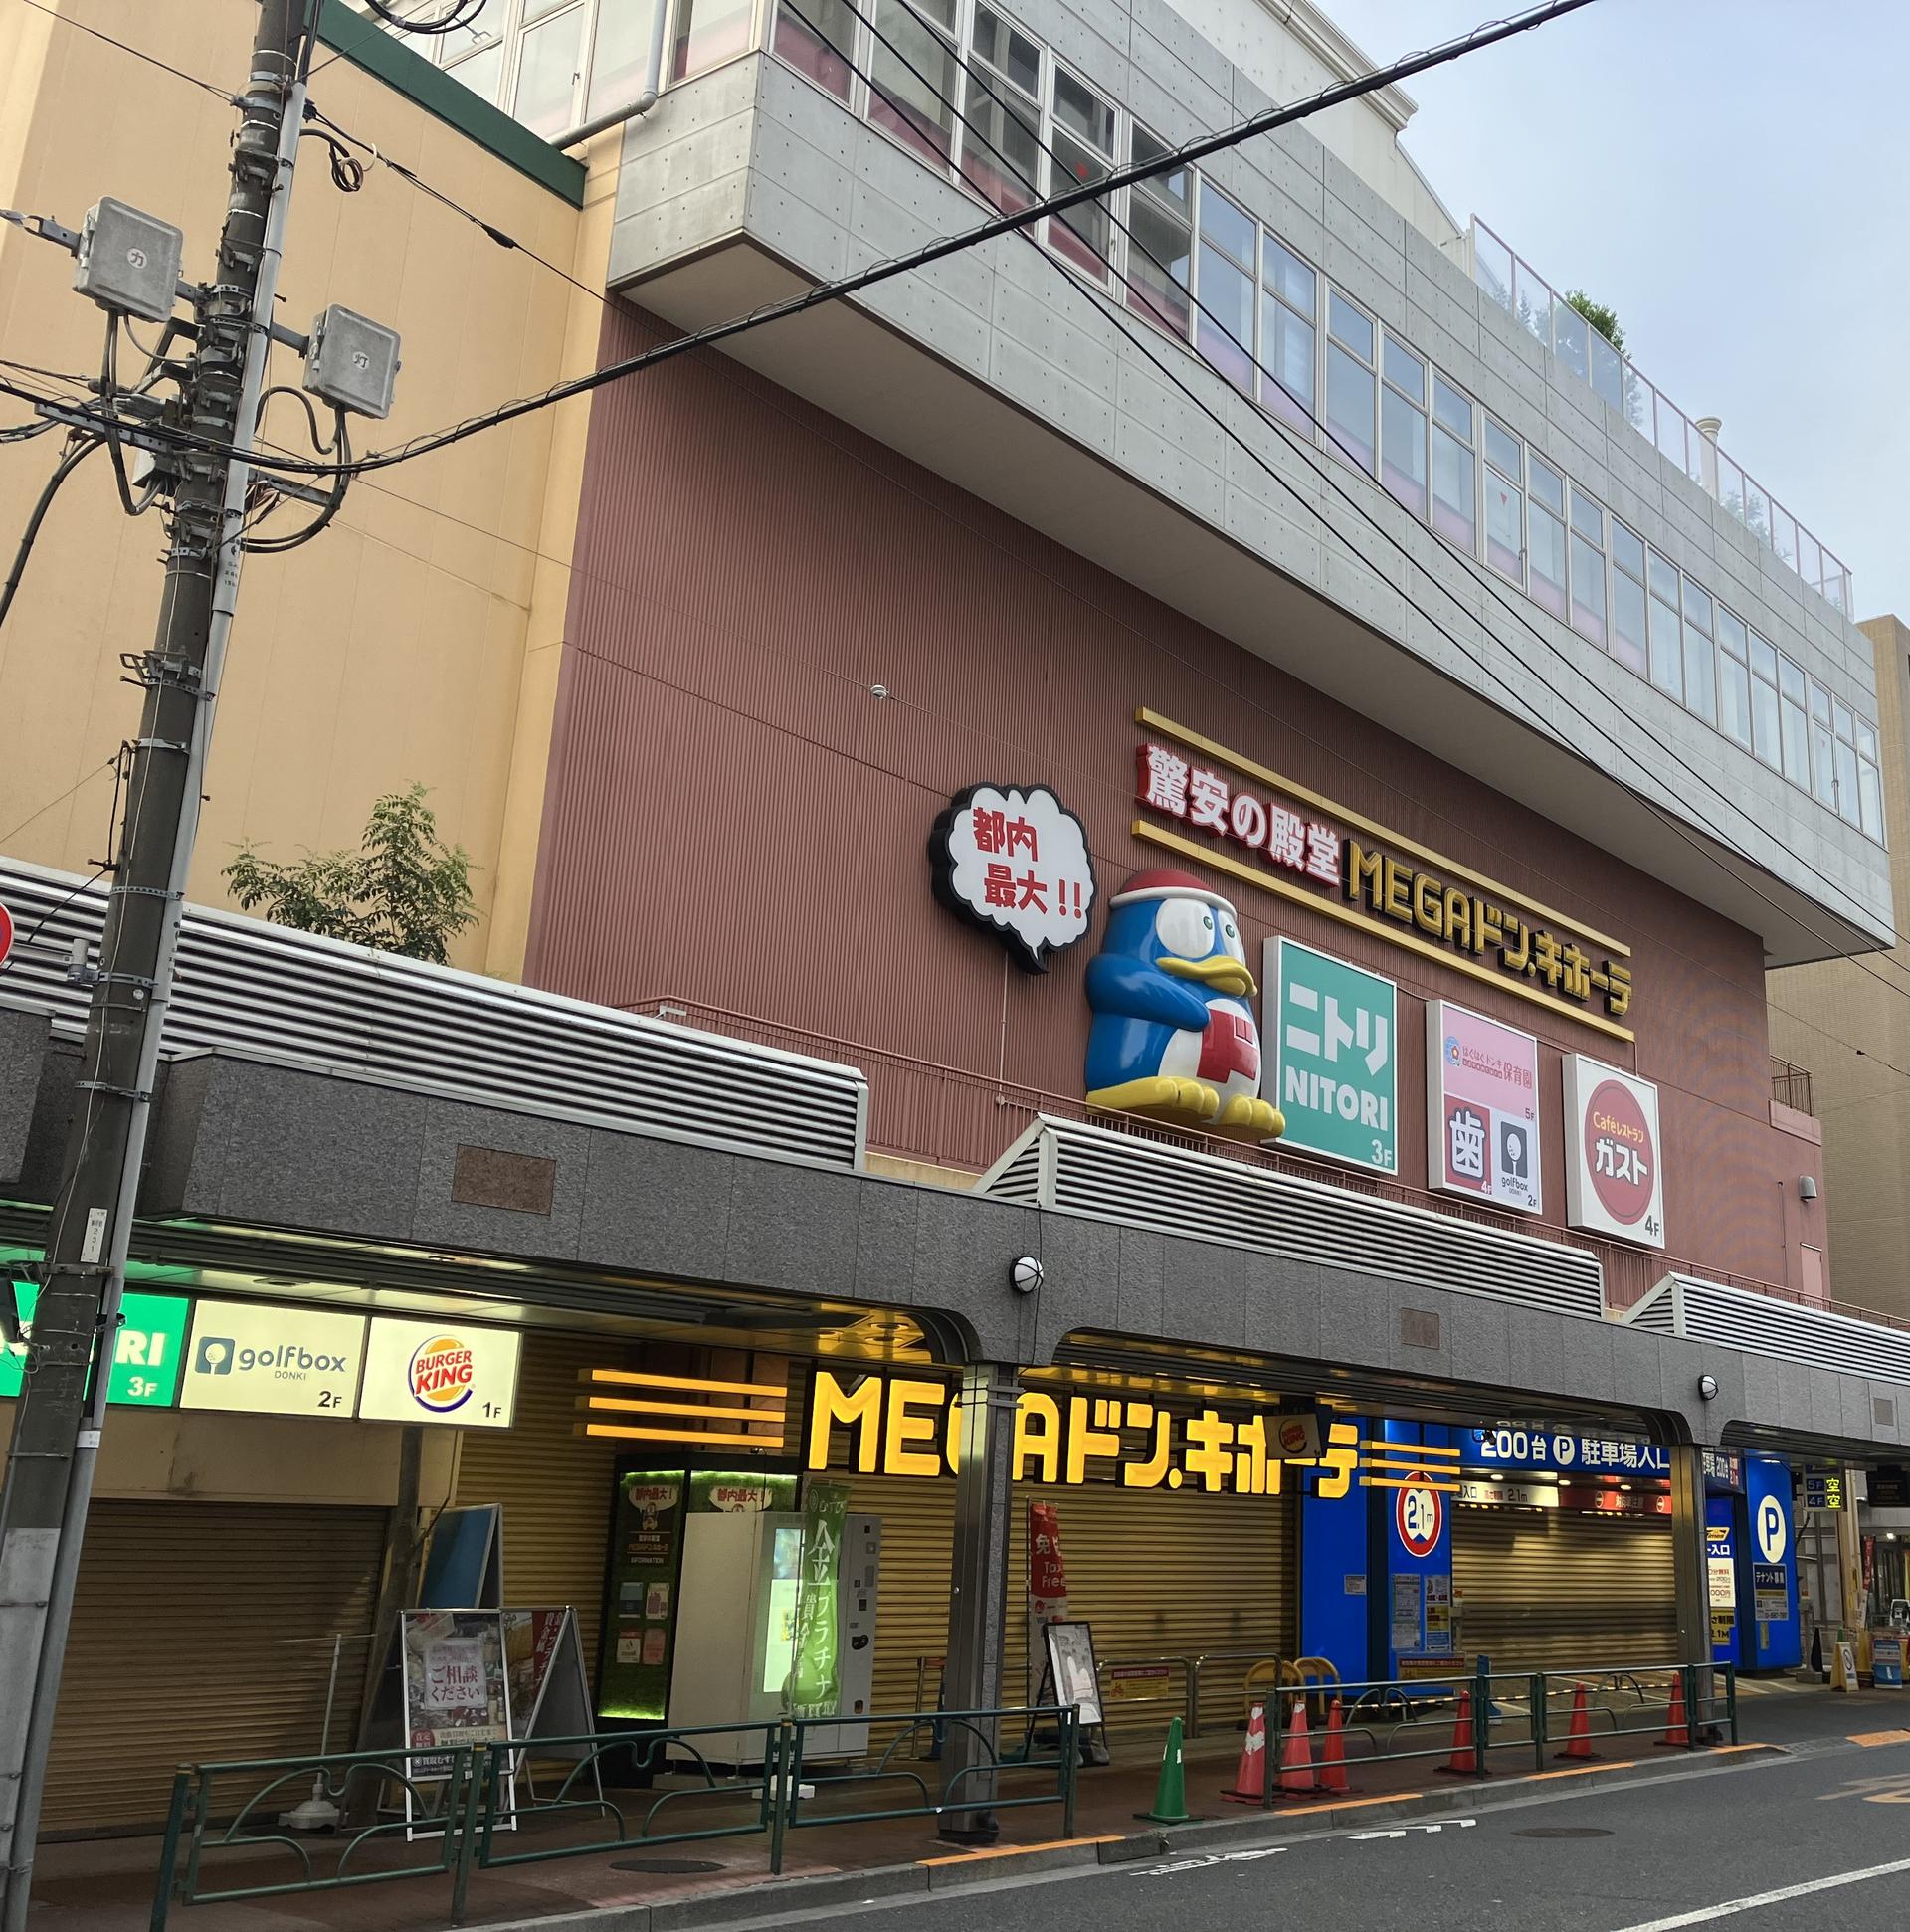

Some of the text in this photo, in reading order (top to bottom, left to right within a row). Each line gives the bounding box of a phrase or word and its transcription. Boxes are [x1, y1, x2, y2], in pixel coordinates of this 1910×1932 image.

[1146, 745, 1340, 886] 驚安の殿堂
[972, 806, 1039, 863] 都内
[1286, 981, 1389, 1077] ニトリ
[1285, 1065, 1389, 1132] NITORI
[1525, 1107, 1535, 1121] 5F
[1371, 1138, 1393, 1167] 3F
[1449, 1110, 1485, 1179] 歯
[1596, 1138, 1648, 1186] ガスト
[1501, 1176, 1528, 1192] golfbox
[1527, 1194, 1537, 1208] 2F
[1644, 1214, 1660, 1237] 4F
[238, 1345, 347, 1372] golfbox
[415, 1349, 473, 1375] BURGER
[127, 1376, 159, 1397] 3F
[274, 1370, 307, 1382] DONKI
[415, 1364, 473, 1395] KING
[317, 1390, 343, 1409] 2F
[482, 1401, 502, 1419] 1F
[1808, 1496, 1823, 1506] 4F
[1044, 1561, 1063, 1574] Tax
[1041, 1576, 1067, 1589] Free
[812, 1590, 833, 1700] プラチナ
[431, 1664, 478, 1684] ご相談
[431, 1686, 480, 1703] ください
